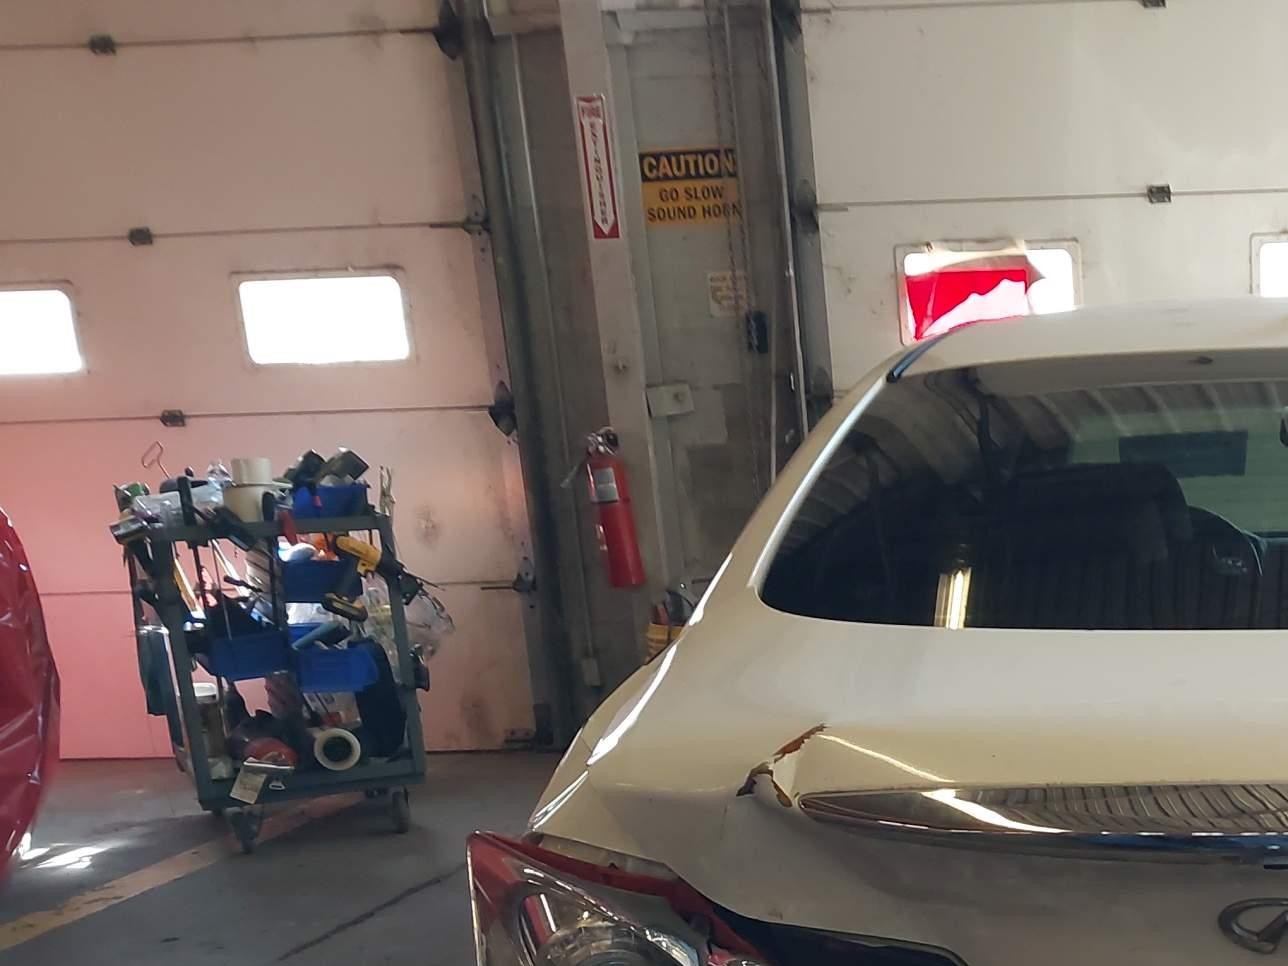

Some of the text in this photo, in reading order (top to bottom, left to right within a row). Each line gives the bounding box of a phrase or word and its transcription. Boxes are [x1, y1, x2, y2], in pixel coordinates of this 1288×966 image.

[642, 151, 736, 179] CAUTION
[659, 185, 723, 202] GO SLOW
[647, 205, 697, 222] SOUND
